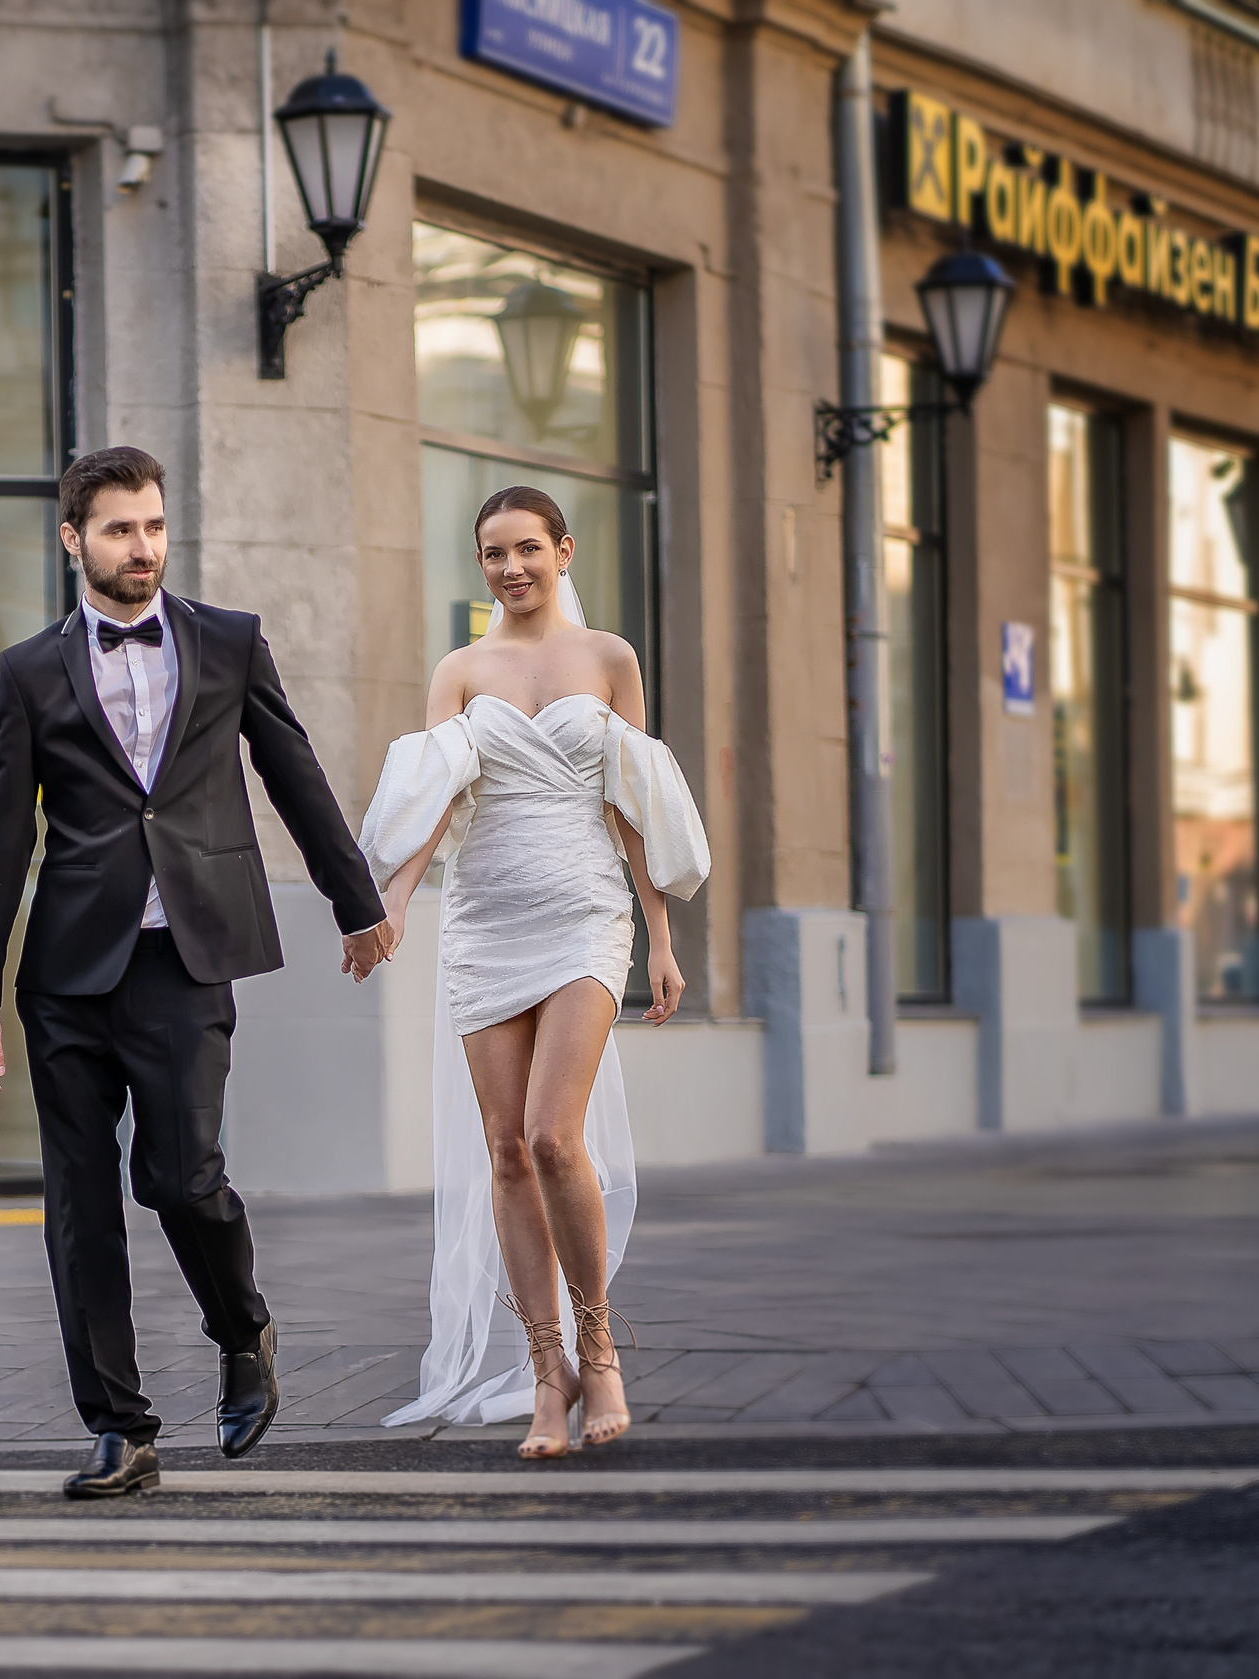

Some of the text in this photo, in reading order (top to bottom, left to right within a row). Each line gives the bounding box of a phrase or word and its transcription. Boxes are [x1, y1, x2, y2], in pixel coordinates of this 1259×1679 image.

[496, 0, 611, 46] НИЦКАЯ
[632, 16, 667, 80] 22
[956, 113, 1237, 323] Райффайзен
